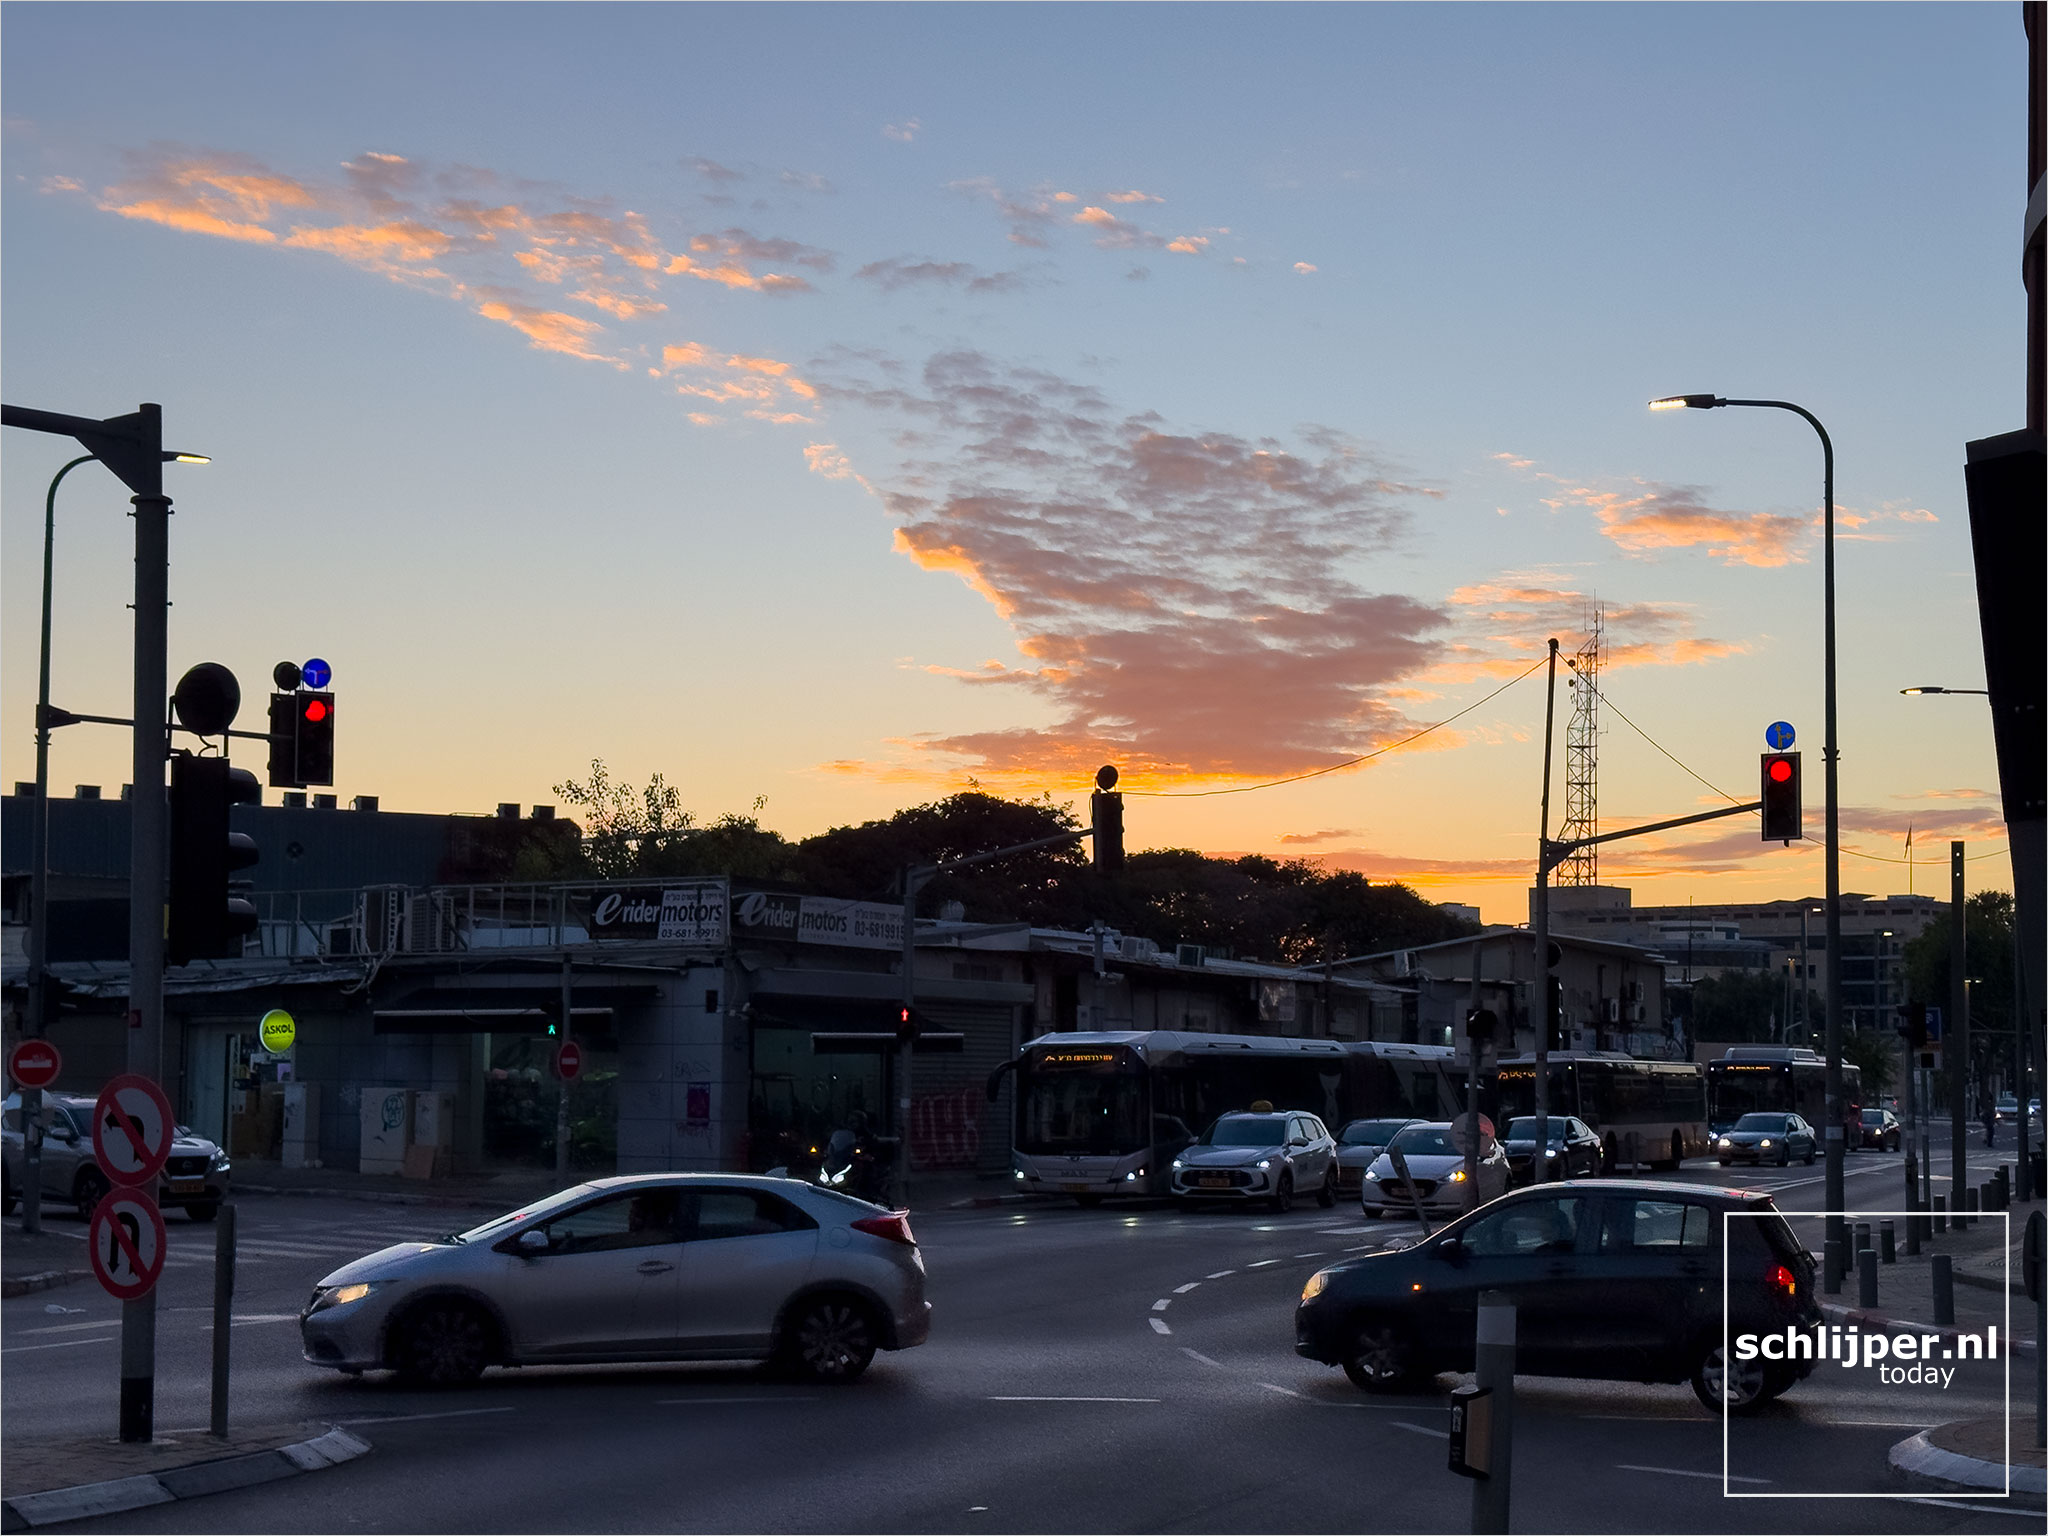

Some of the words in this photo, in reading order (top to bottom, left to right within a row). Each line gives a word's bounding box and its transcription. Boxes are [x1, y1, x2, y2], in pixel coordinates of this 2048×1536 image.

[661, 901, 723, 922] motors
[801, 910, 848, 933] motors
[264, 1024, 294, 1035] ASKOL
